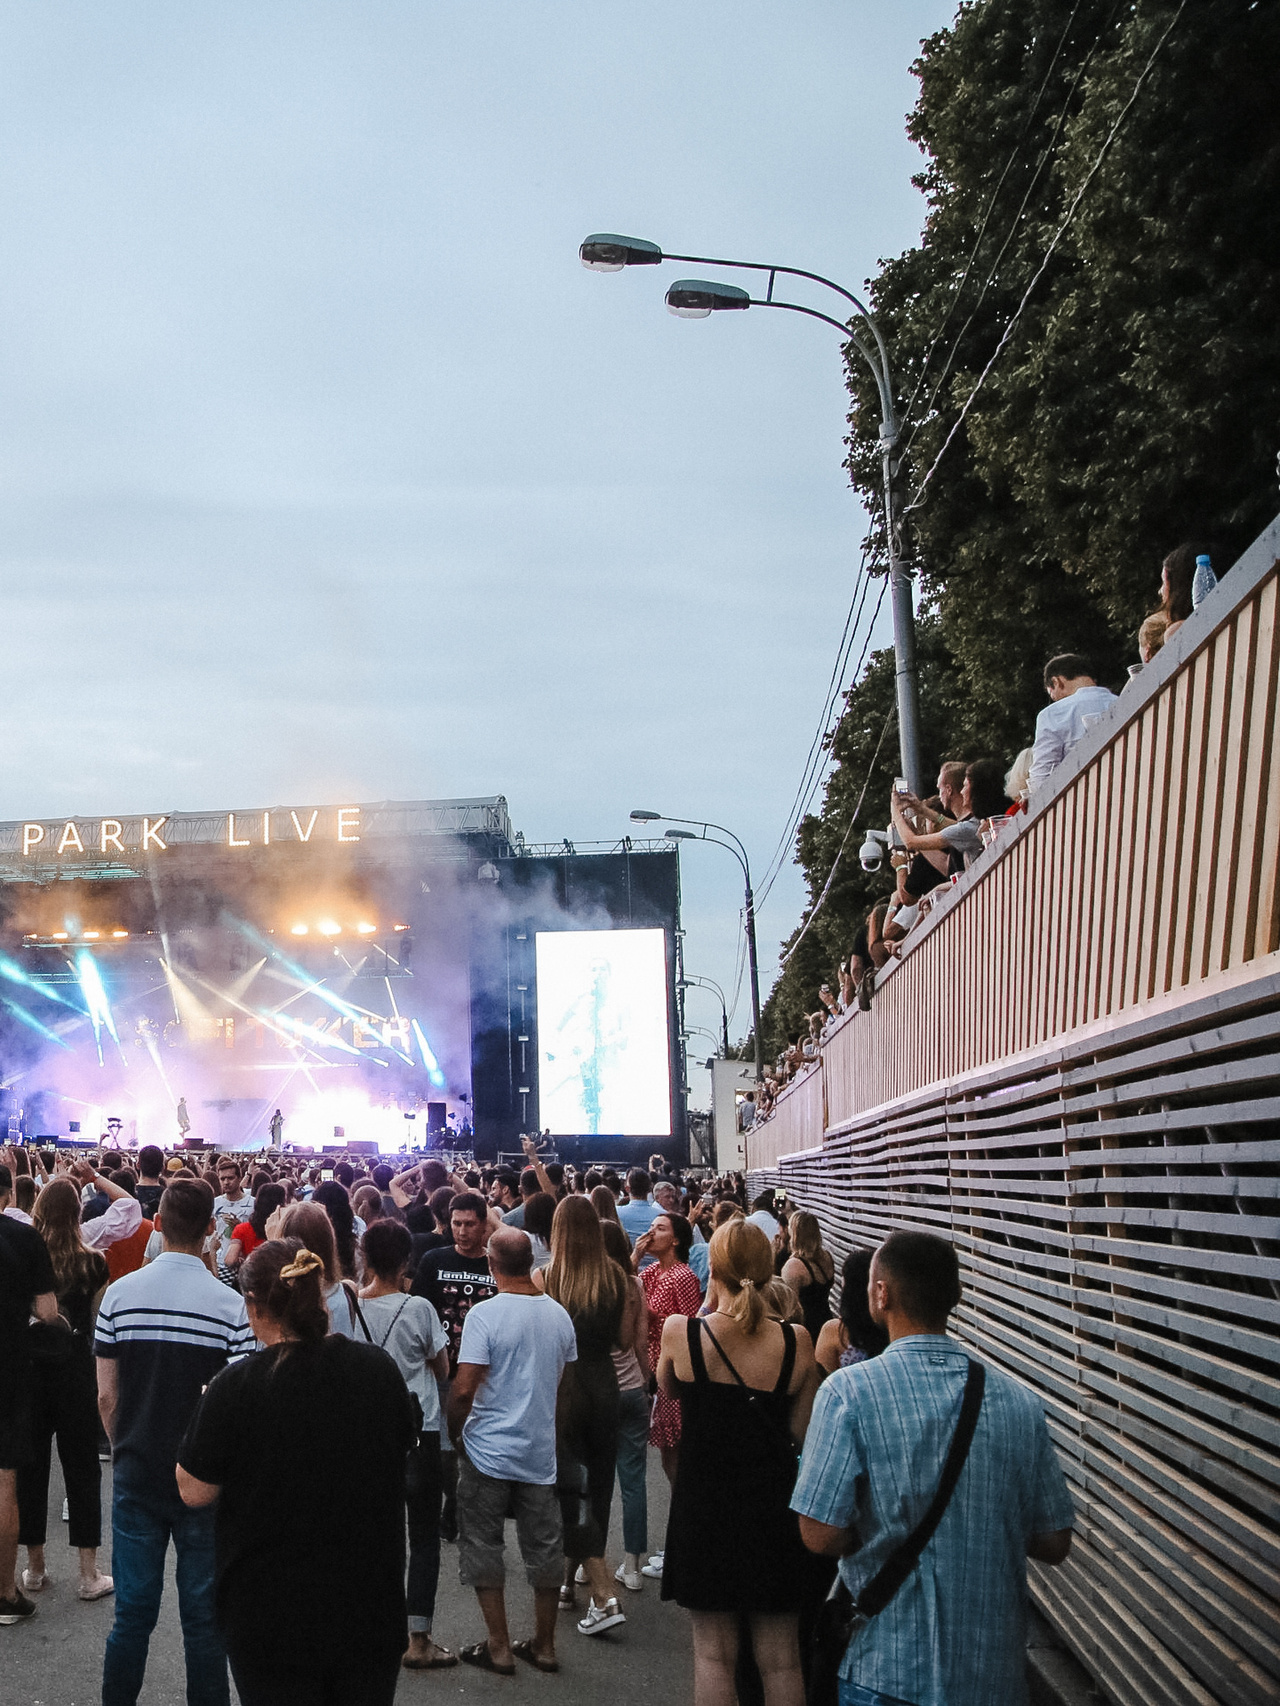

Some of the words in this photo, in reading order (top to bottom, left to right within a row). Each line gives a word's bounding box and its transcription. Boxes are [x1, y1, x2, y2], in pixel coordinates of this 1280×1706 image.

[22, 816, 169, 855] PARK
[227, 807, 361, 847] LIVE
[437, 1270, 498, 1287] Lambrett
